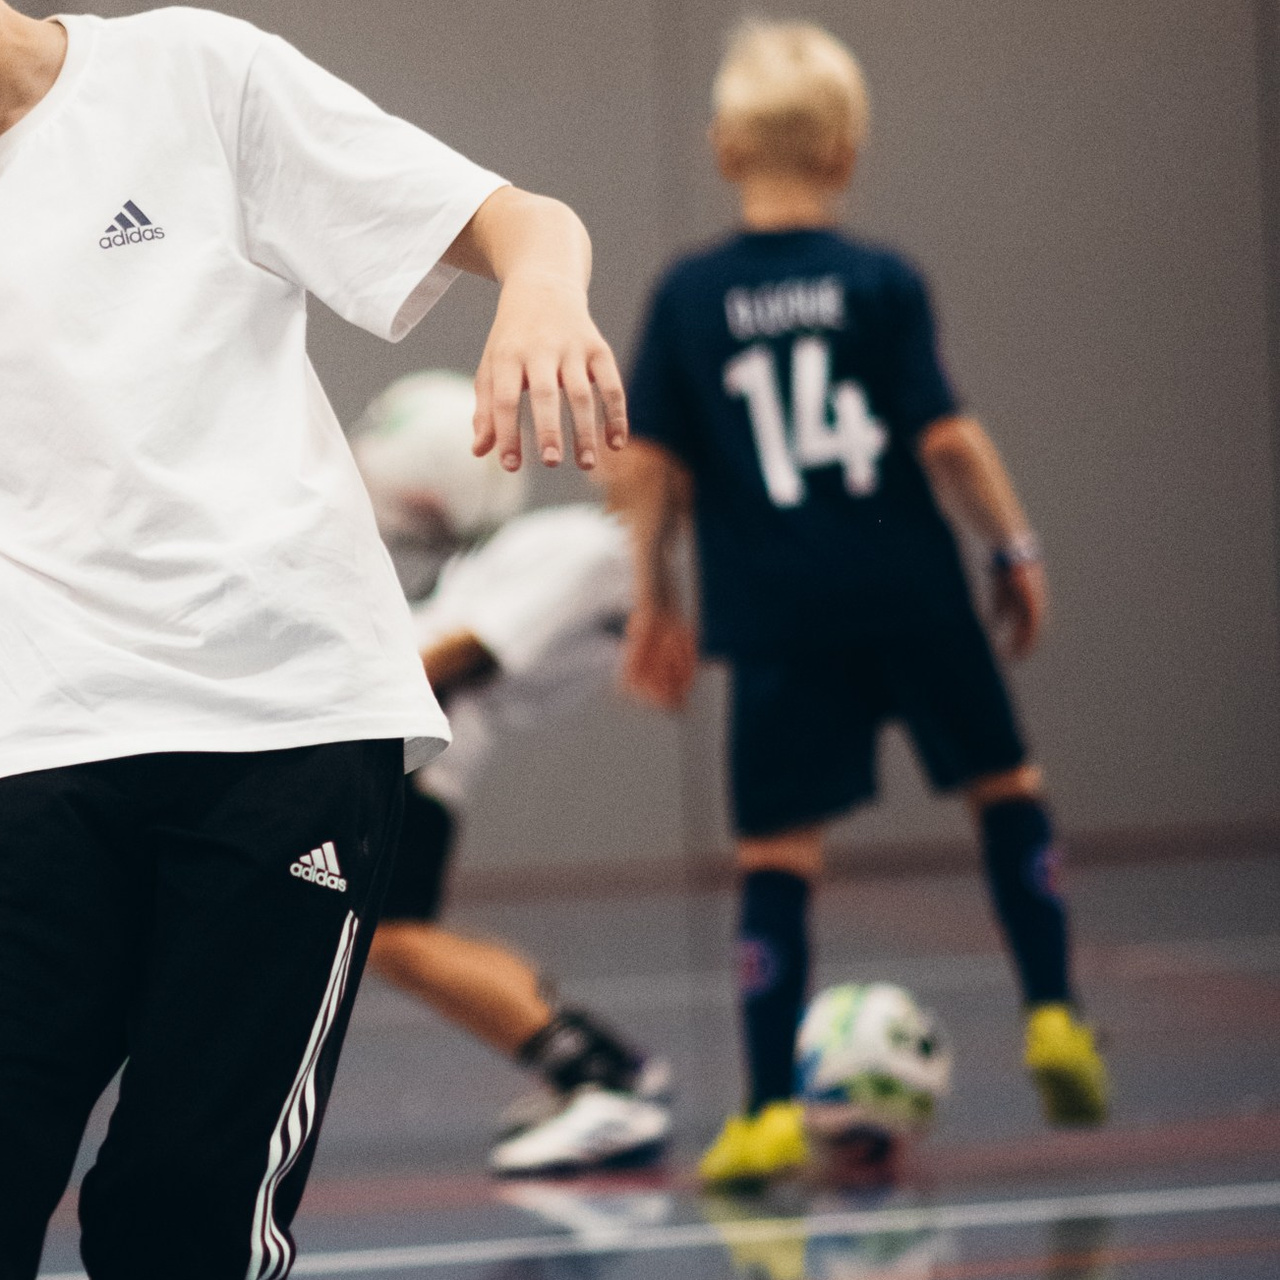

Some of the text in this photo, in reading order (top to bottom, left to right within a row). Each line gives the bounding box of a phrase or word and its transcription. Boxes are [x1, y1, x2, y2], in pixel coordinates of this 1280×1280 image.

[99, 227, 165, 249] adidas
[723, 337, 888, 508] 14
[289, 862, 347, 892] adidas
